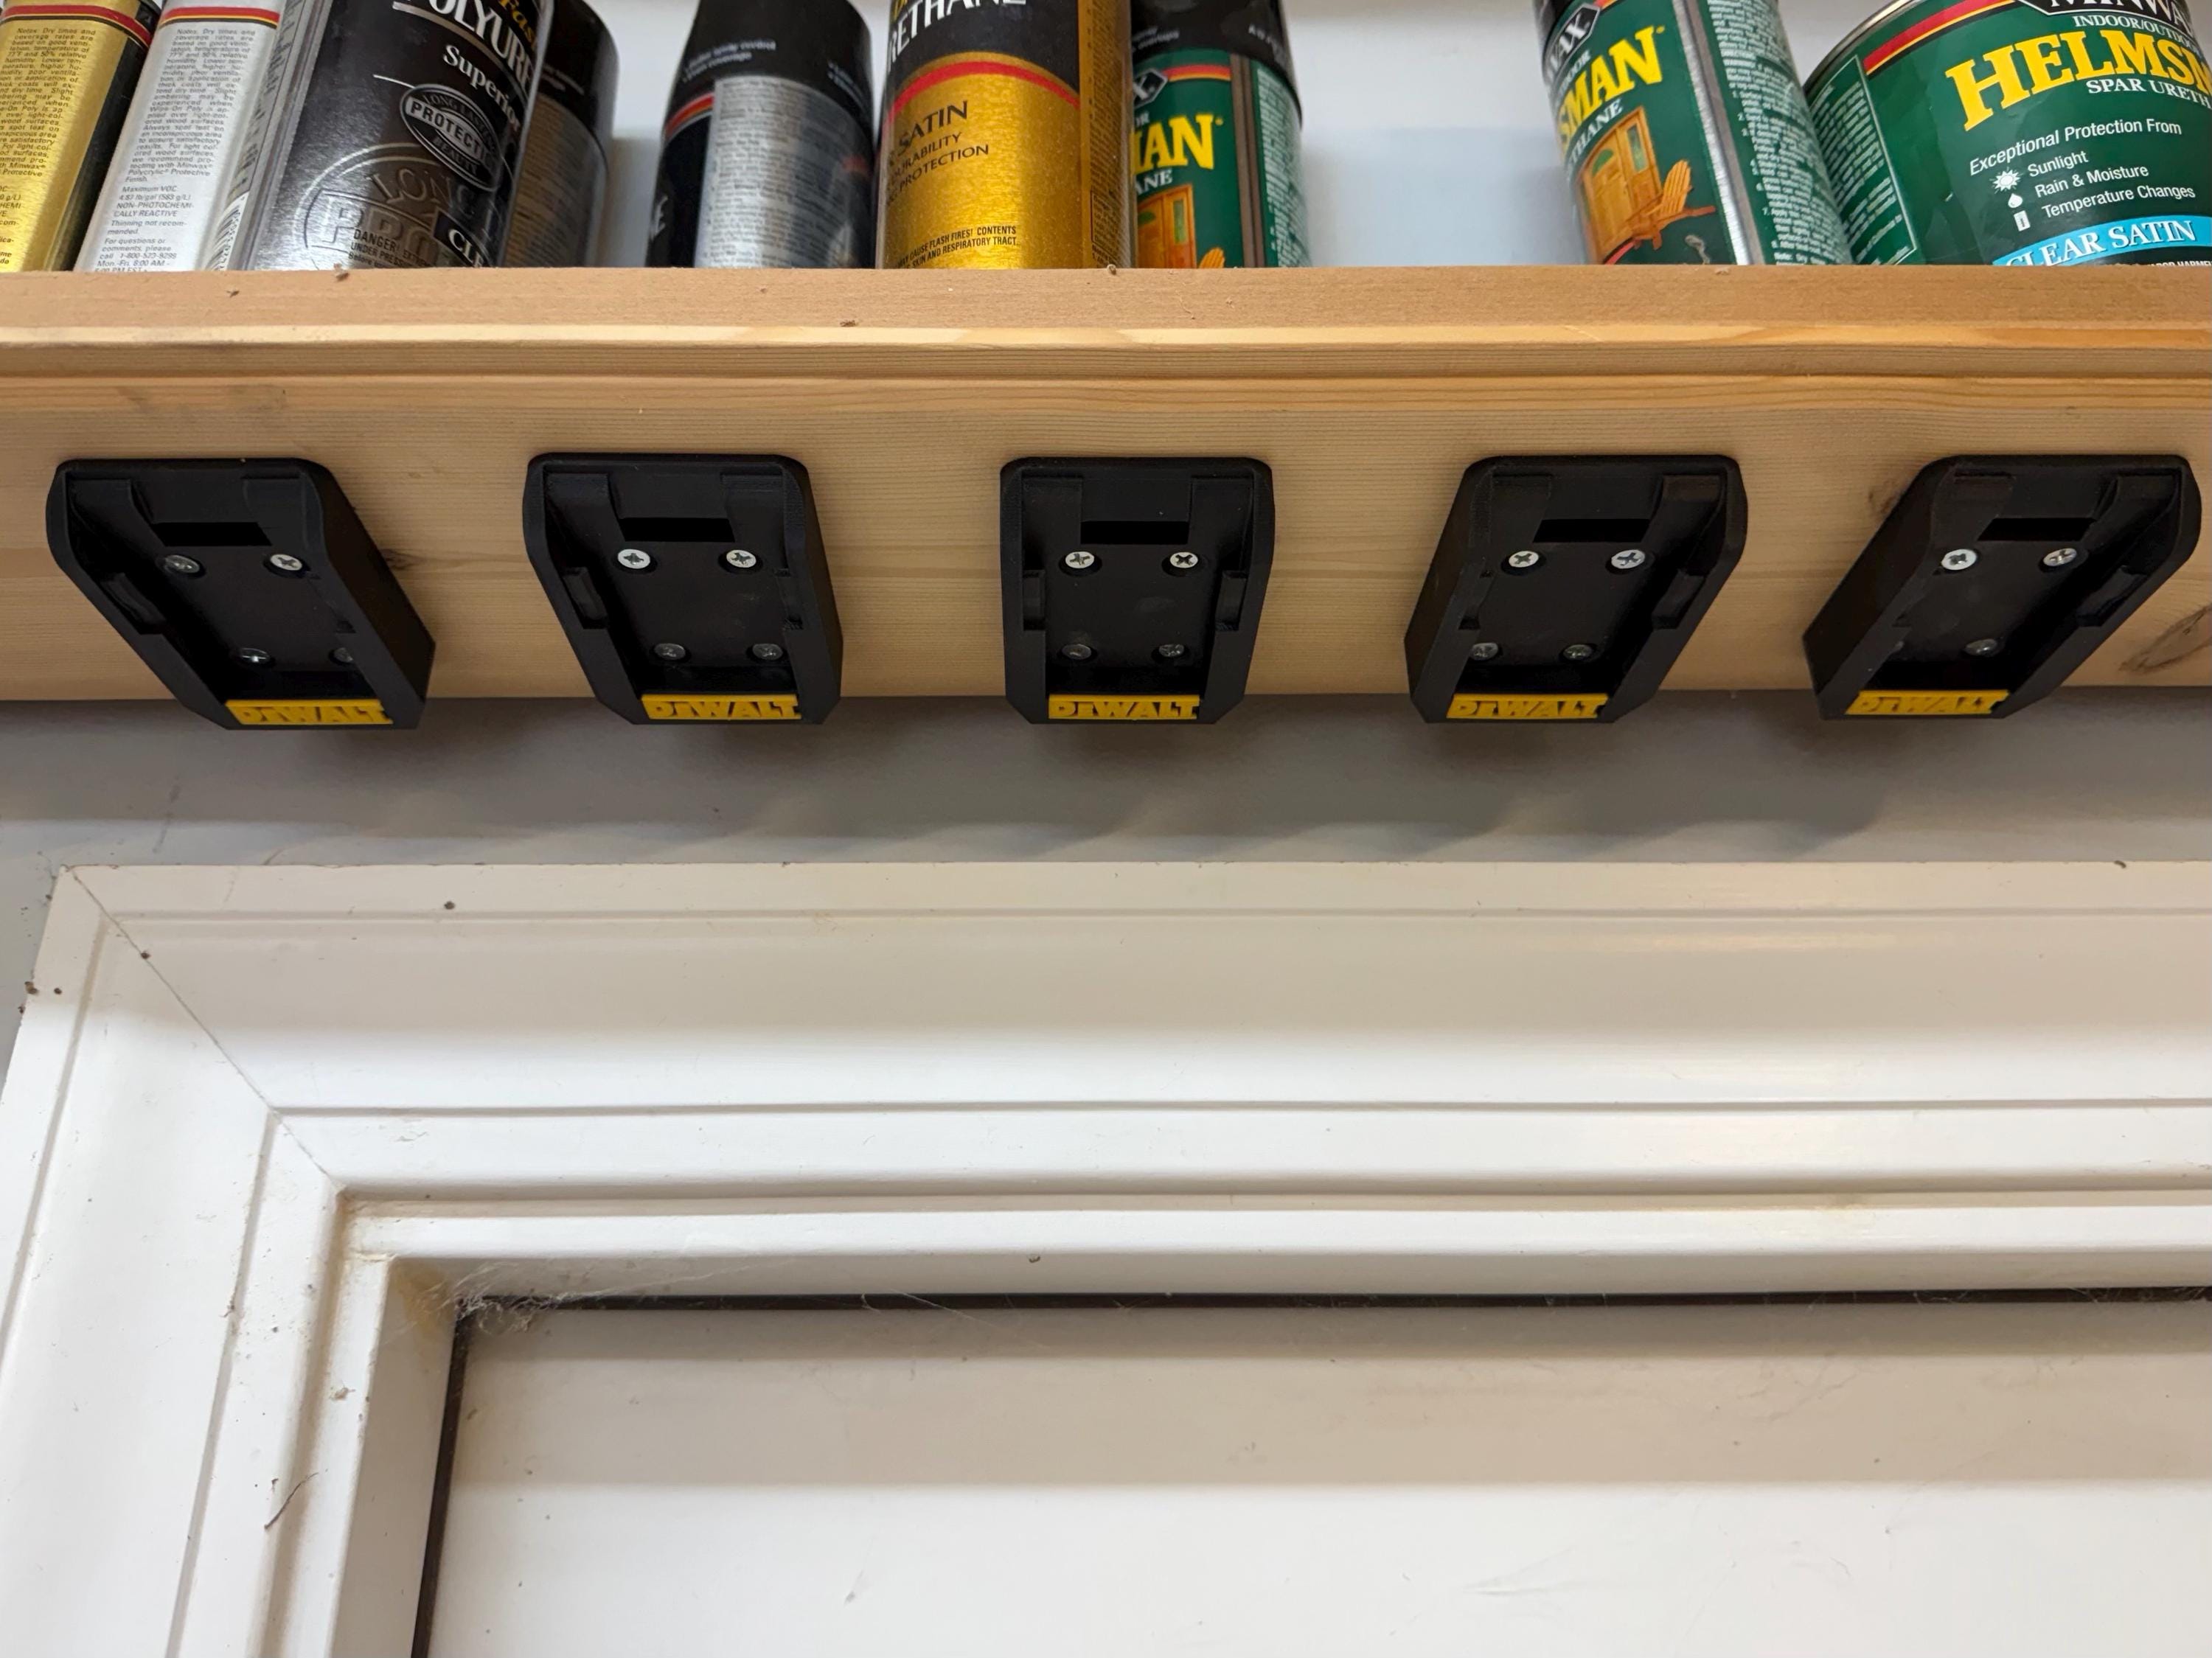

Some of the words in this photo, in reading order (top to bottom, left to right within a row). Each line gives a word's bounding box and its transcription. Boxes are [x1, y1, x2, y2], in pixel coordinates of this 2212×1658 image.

[2086, 77, 2147, 94] SPAR
[897, 100, 968, 157] SATIN
[1969, 130, 2059, 176] Exceptional
[2065, 120, 2143, 142] Protection
[2146, 118, 2183, 136] From
[900, 144, 990, 192] PROTECTION
[2028, 150, 2089, 178] Sunlight
[2035, 178, 2068, 198] Rain
[2072, 173, 2084, 188] &
[2086, 164, 2149, 185] Moisture
[2042, 189, 2134, 219] Temperature
[2137, 186, 2197, 201] Changes
[928, 249, 942, 260] AND
[942, 237, 992, 254] RESPIRATORY
[929, 235, 950, 250] FLASH
[977, 226, 1017, 236] CONTENTS
[2006, 231, 2107, 267] CLEAR
[2107, 220, 2197, 249] SATIN
